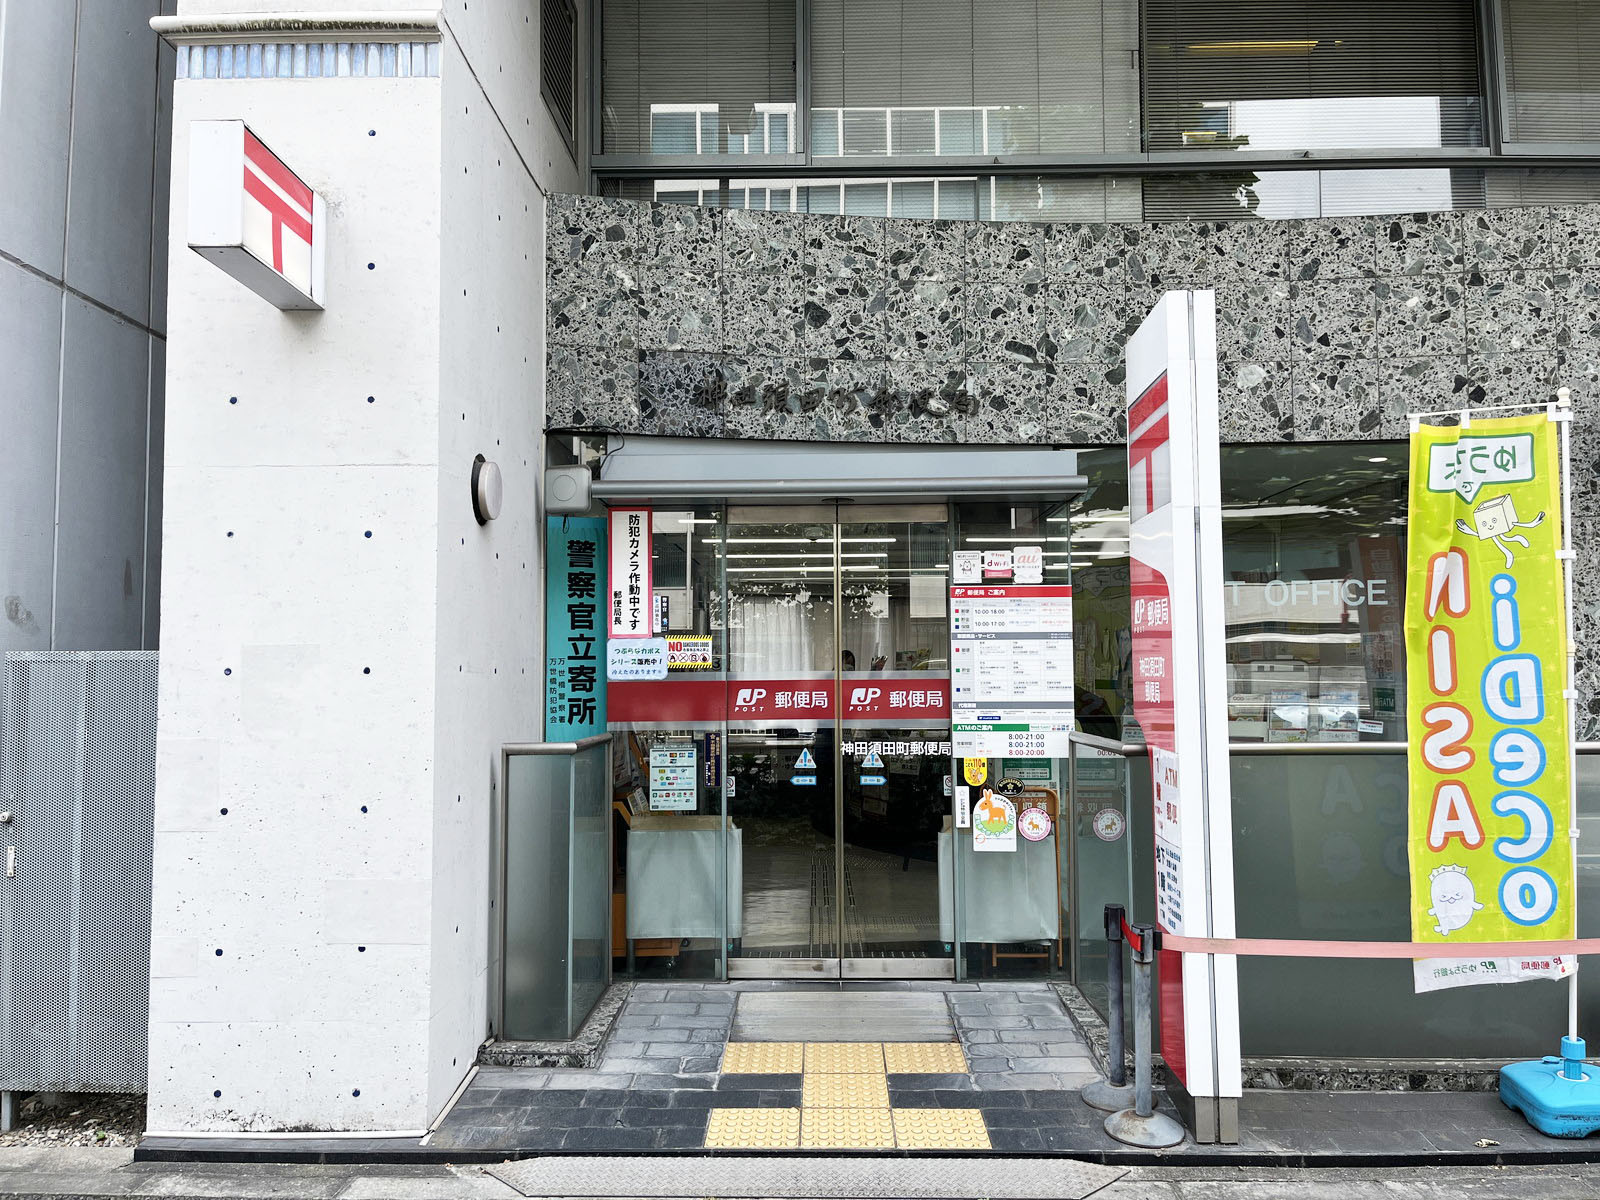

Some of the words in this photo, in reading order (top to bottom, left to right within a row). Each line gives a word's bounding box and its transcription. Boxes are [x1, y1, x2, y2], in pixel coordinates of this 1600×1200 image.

[1017, 555, 1037, 564] au
[628, 514, 640, 630] 防犯カメラ作動中です
[1264, 579, 1388, 606] OFFICE
[613, 591, 622, 625] 郵便局長
[1147, 597, 1169, 626] 郵便局
[567, 539, 597, 726] 警察官立寄所
[668, 642, 682, 652] NO
[557, 658, 566, 724] 万世橋警察署
[736, 688, 766, 705] JP
[774, 691, 828, 709] 郵便局
[850, 687, 881, 705] JP
[889, 690, 943, 708] 郵便局
[840, 741, 952, 755] 神田須田町郵便局
[1164, 767, 1178, 788] ATM
